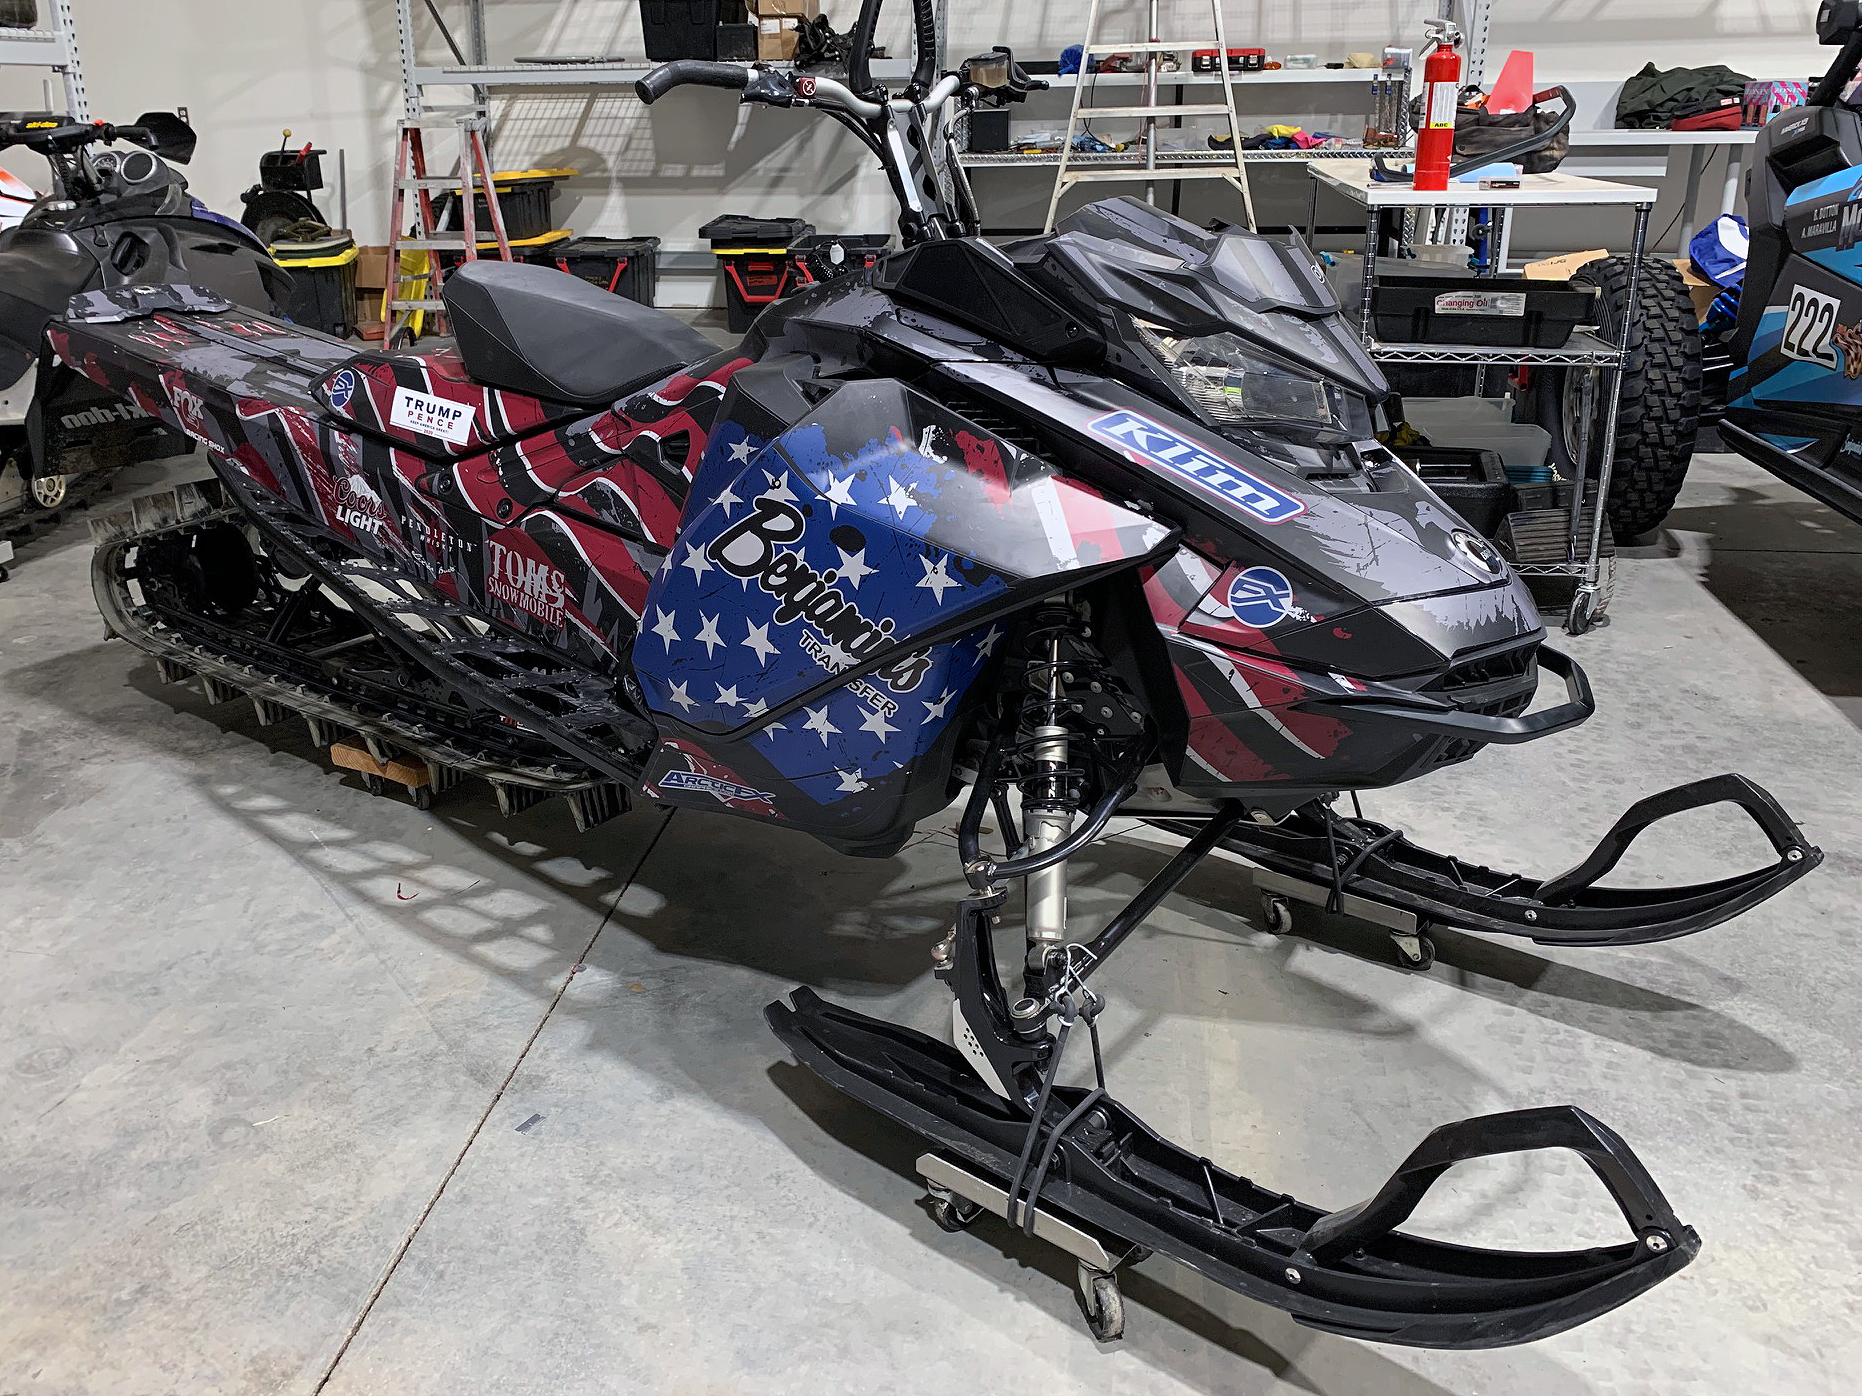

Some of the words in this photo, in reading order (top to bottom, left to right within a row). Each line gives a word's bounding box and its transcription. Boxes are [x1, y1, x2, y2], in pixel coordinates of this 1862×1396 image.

[1783, 291, 1834, 362] 222
[172, 385, 204, 421] FOX
[404, 396, 463, 421] TRUMP
[407, 410, 454, 430] PENCE
[332, 475, 388, 520] Coors
[335, 505, 383, 535] LIGHT
[401, 514, 472, 553] PENDLETON
[487, 576, 564, 628] SNOWMOBILE
[798, 628, 899, 719] TRANSFER
